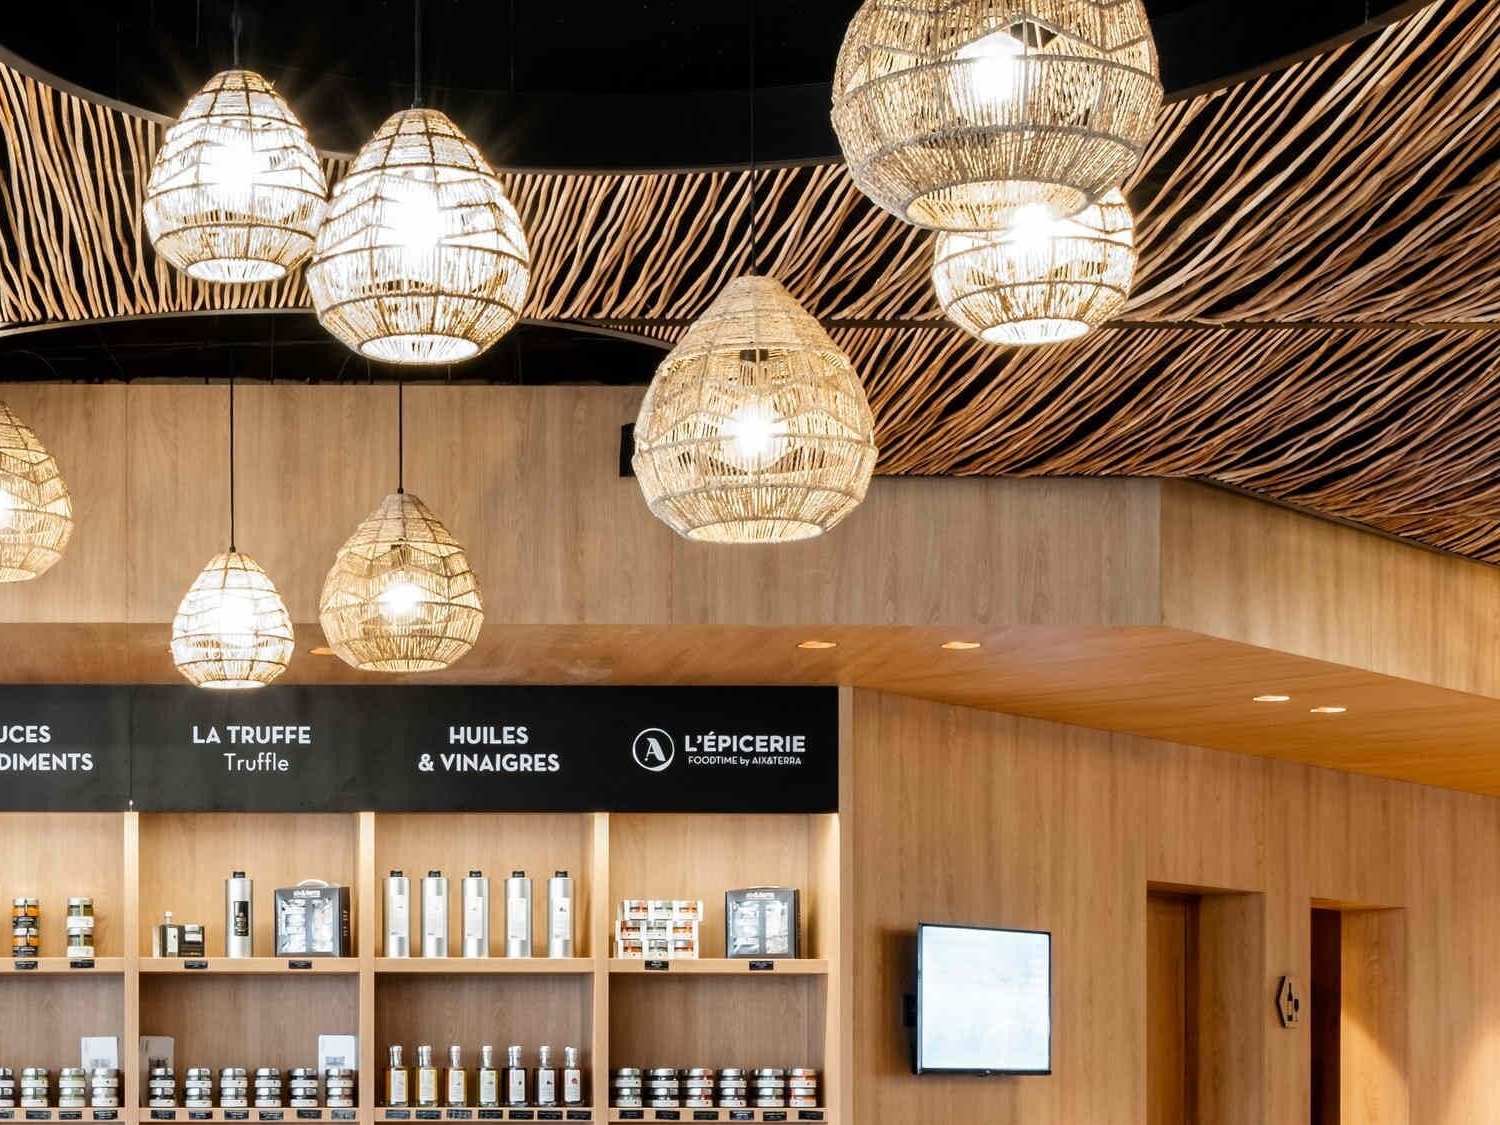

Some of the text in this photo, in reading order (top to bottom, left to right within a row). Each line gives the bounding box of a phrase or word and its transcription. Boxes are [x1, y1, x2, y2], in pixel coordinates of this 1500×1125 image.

[192, 725, 312, 745] LA TRUFFE
[449, 726, 529, 745] HUILES
[684, 731, 806, 753] L'ÉPICERIE
[223, 751, 290, 772] Truffle
[418, 753, 560, 772] & VINAIGRES
[688, 755, 738, 765] FOODTIME
[739, 756, 750, 767] by
